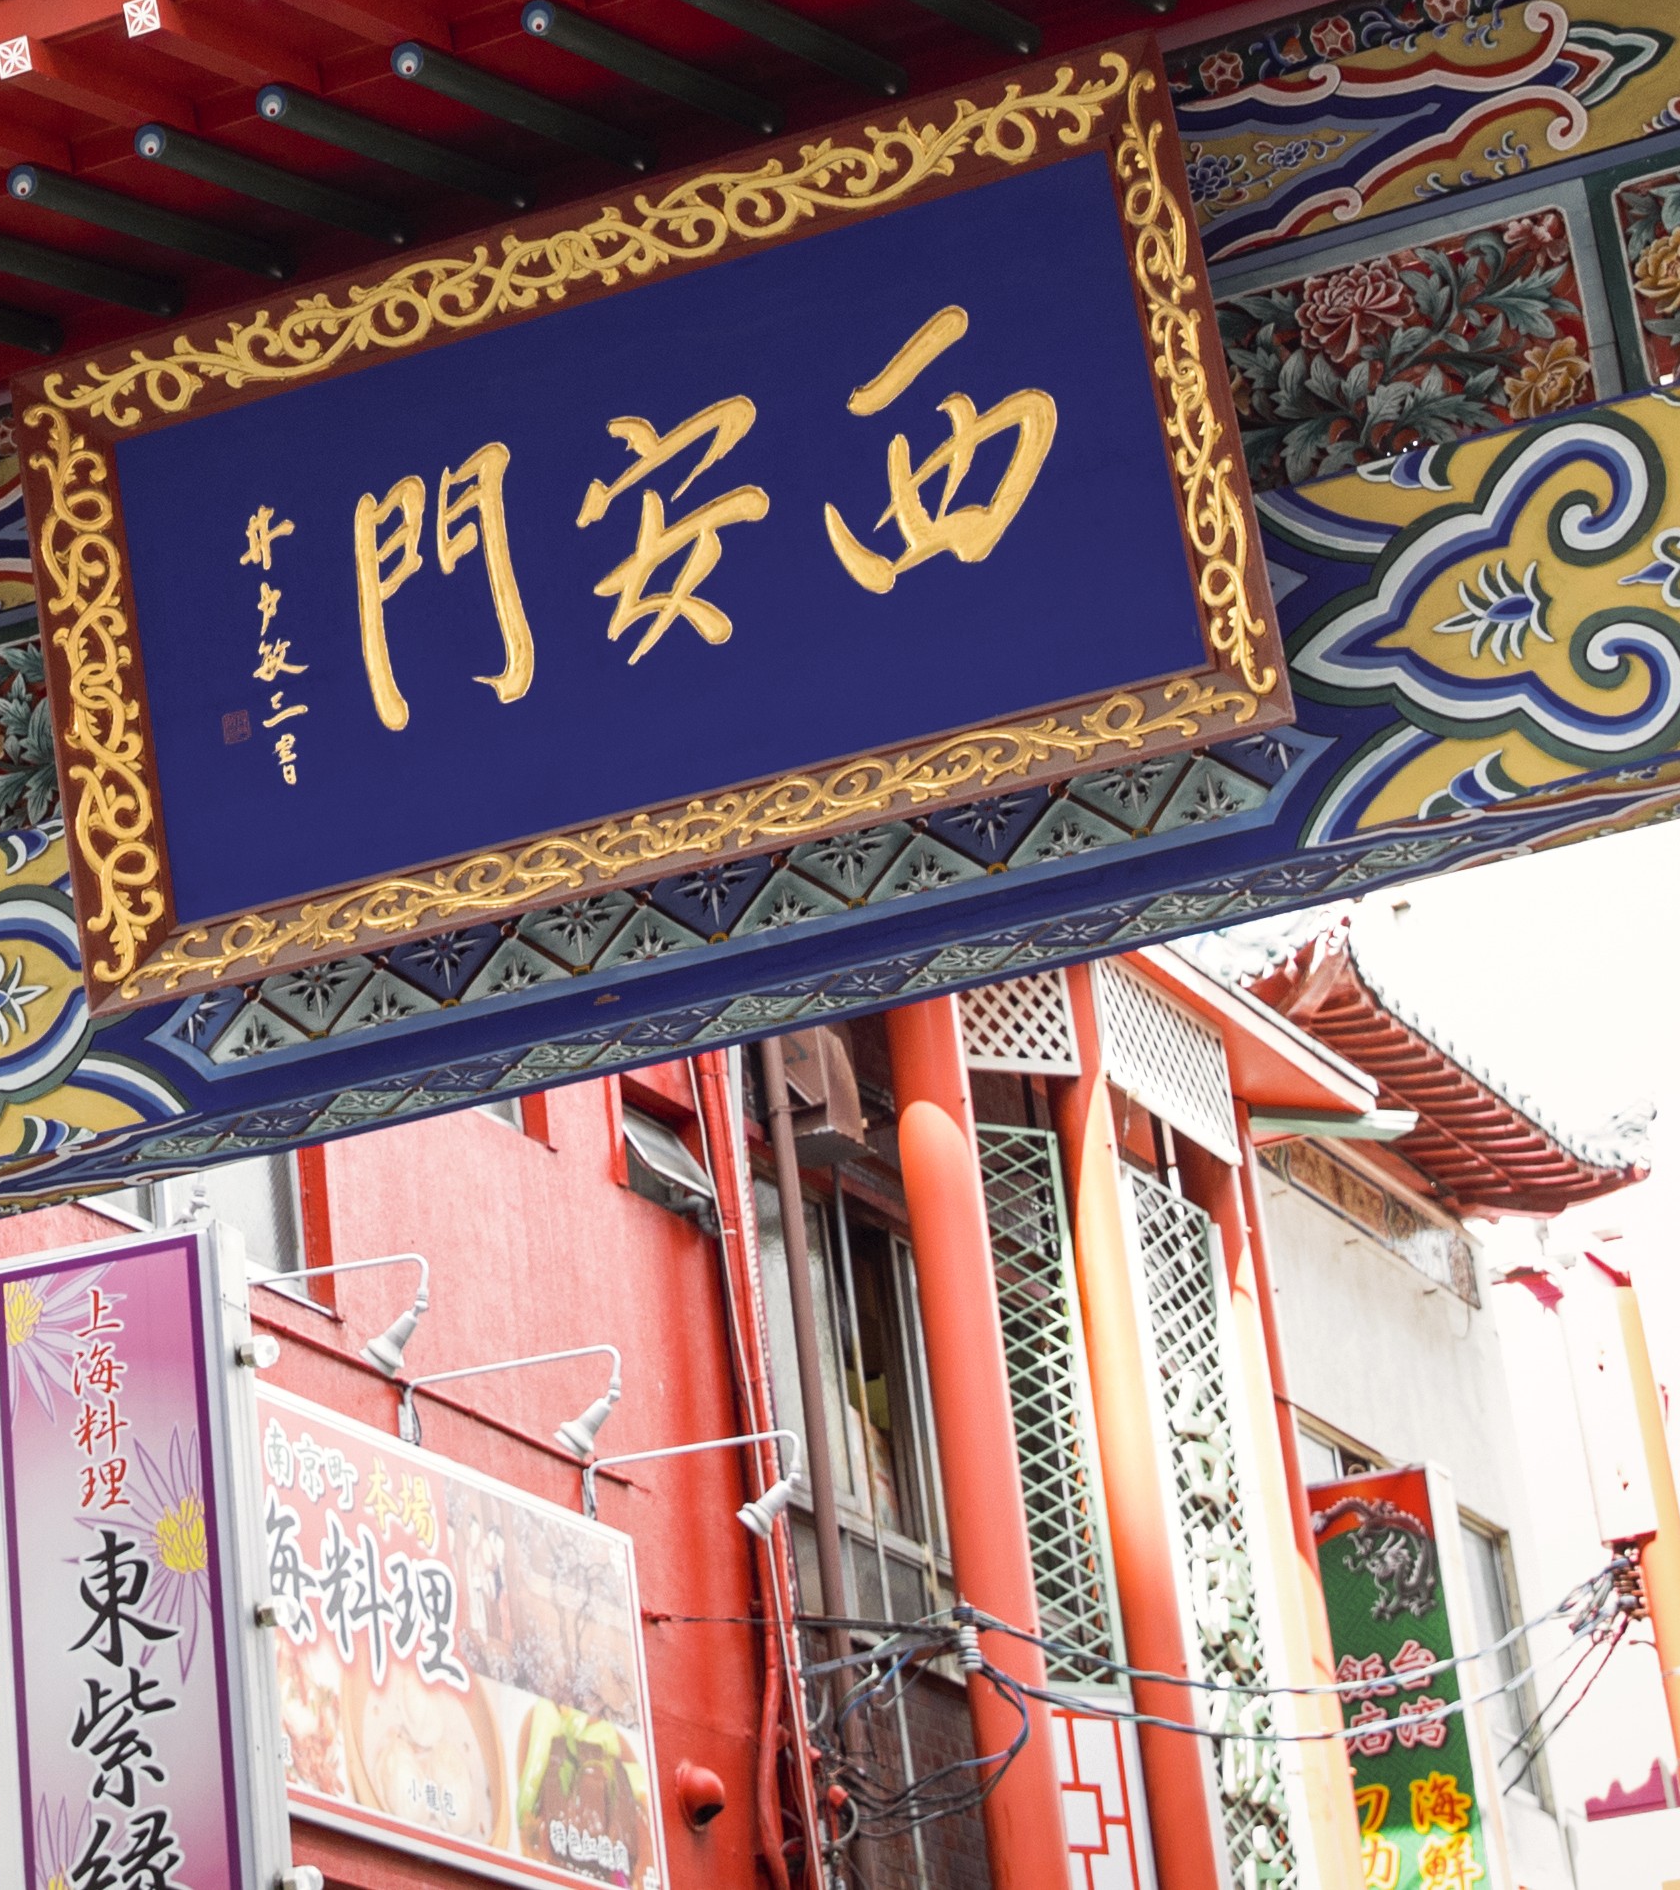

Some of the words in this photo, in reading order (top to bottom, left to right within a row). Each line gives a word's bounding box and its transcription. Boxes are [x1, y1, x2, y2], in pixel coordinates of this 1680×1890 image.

[353, 305, 1059, 733] 西安門
[72, 1287, 132, 1511] 上海料理
[264, 1420, 359, 1510] 南京町
[362, 1456, 439, 1554] 本場
